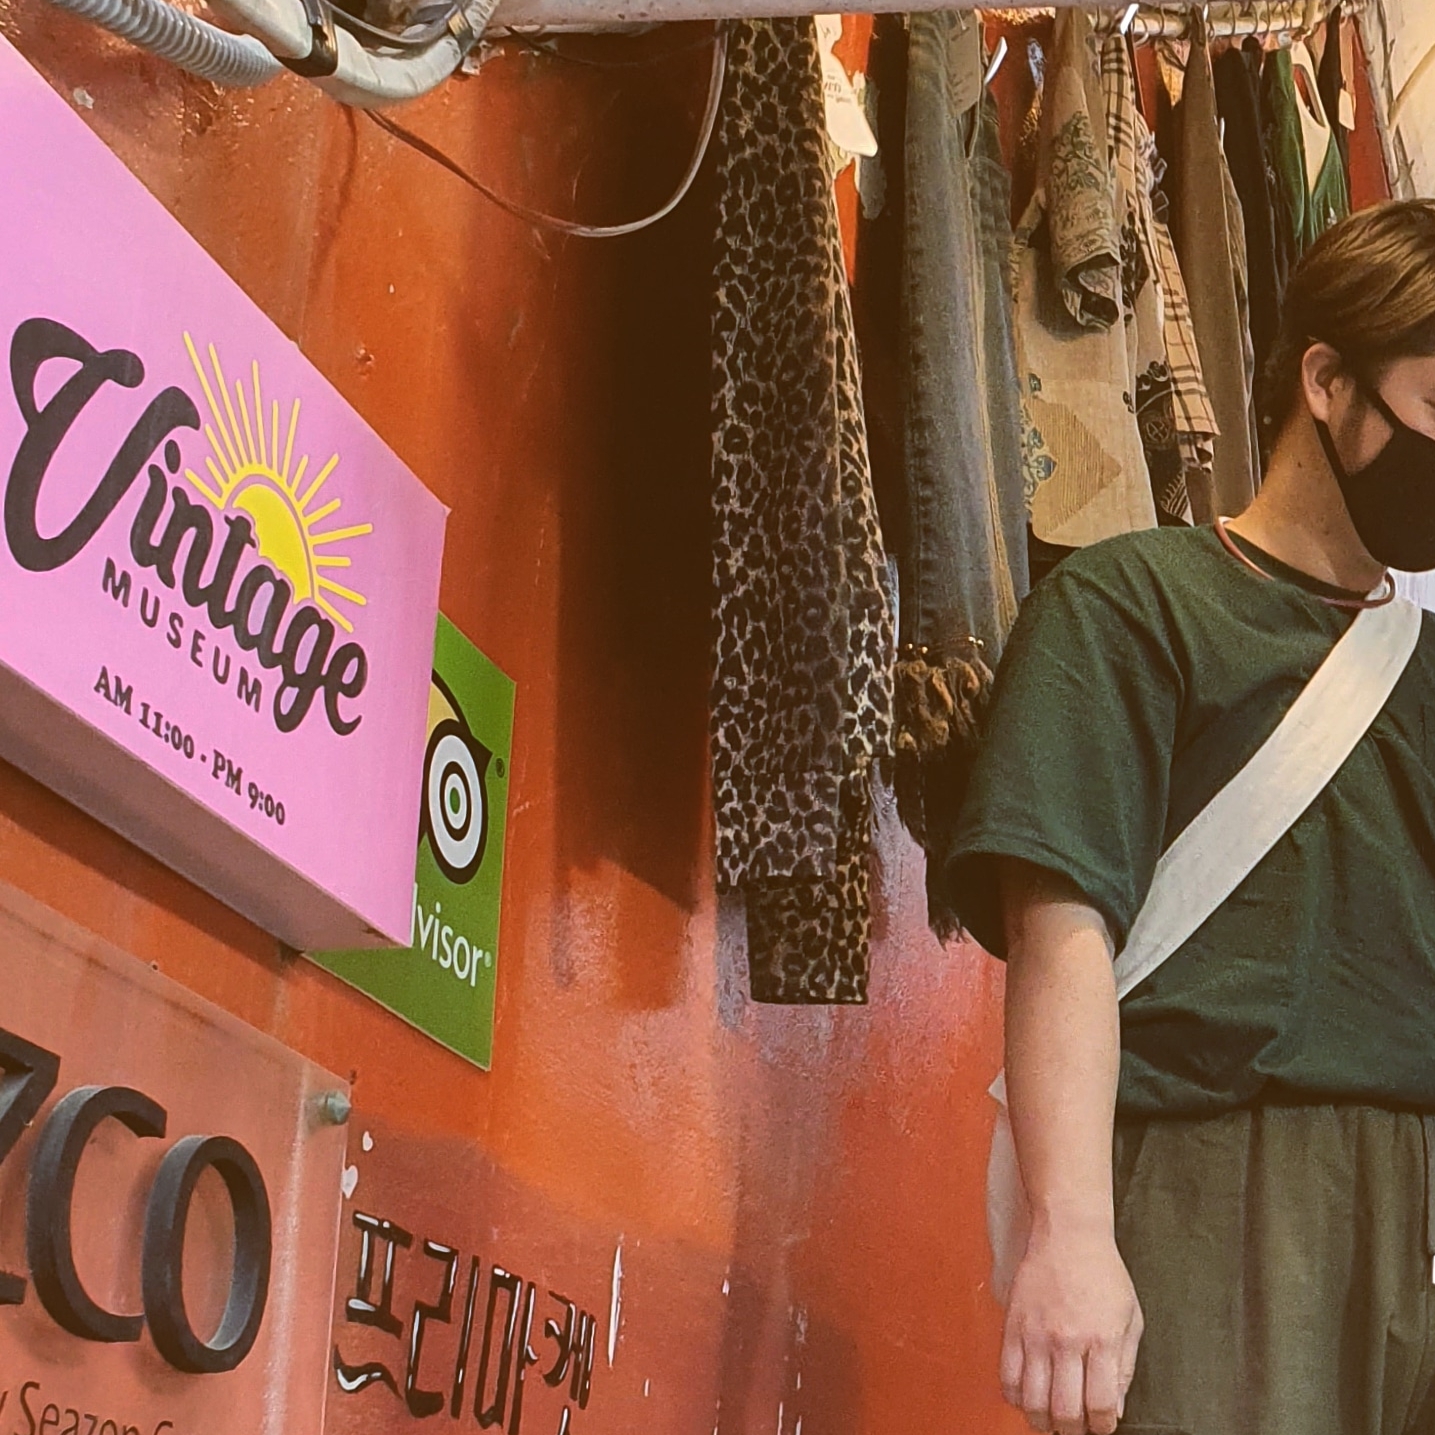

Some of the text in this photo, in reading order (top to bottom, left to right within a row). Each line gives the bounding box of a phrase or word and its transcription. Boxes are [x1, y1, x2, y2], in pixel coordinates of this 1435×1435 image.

[3, 317, 369, 736] Vintage
[102, 556, 263, 713] MUSEUM
[94, 665, 134, 716] AM
[138, 702, 195, 760] 11:00
[211, 749, 243, 796] PM
[247, 782, 286, 826] 9:00
